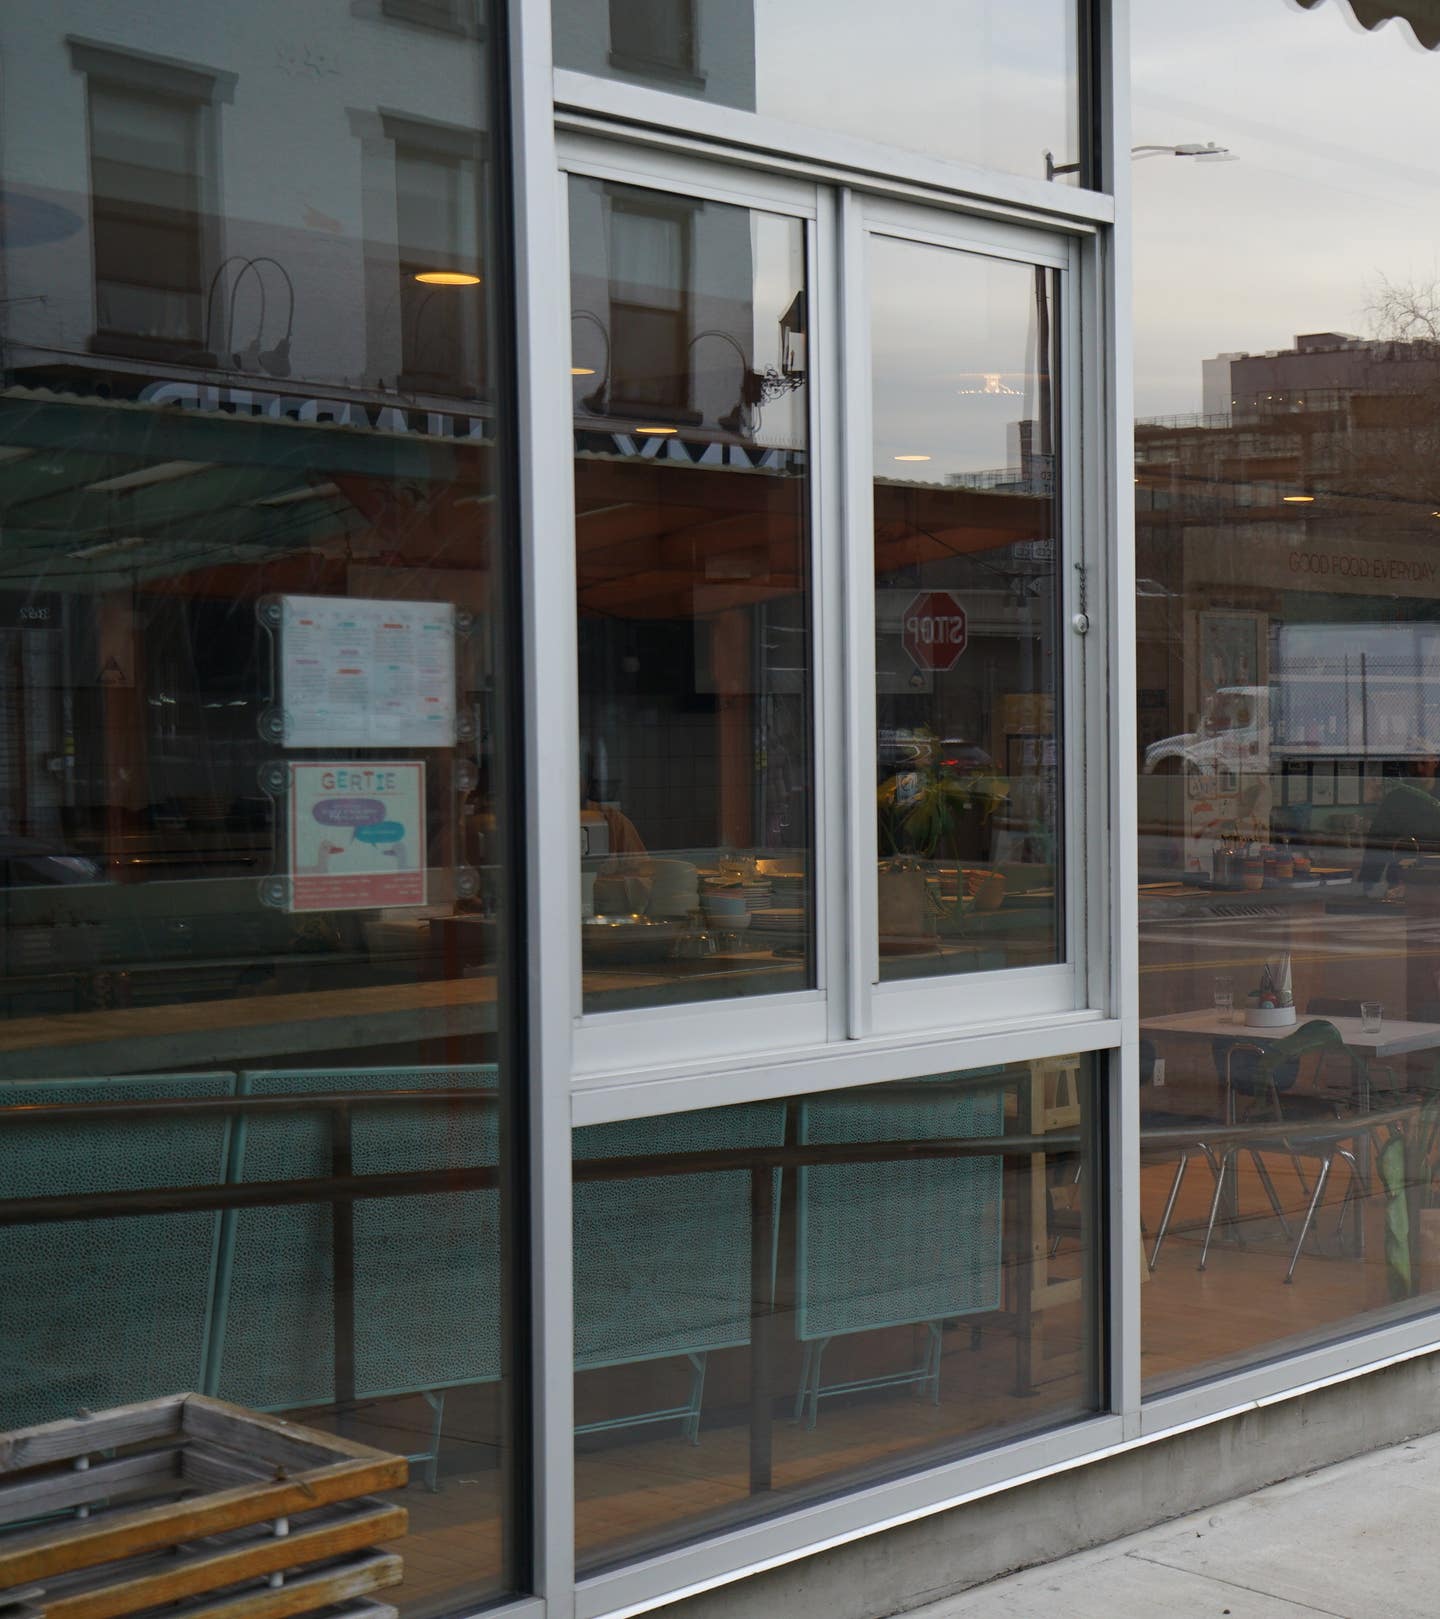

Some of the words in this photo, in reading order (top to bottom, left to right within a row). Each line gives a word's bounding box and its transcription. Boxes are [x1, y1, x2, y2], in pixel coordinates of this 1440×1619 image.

[1288, 551, 1329, 575] GOOD
[1331, 555, 1369, 577] FOOD
[321, 770, 396, 792] GERTIE
